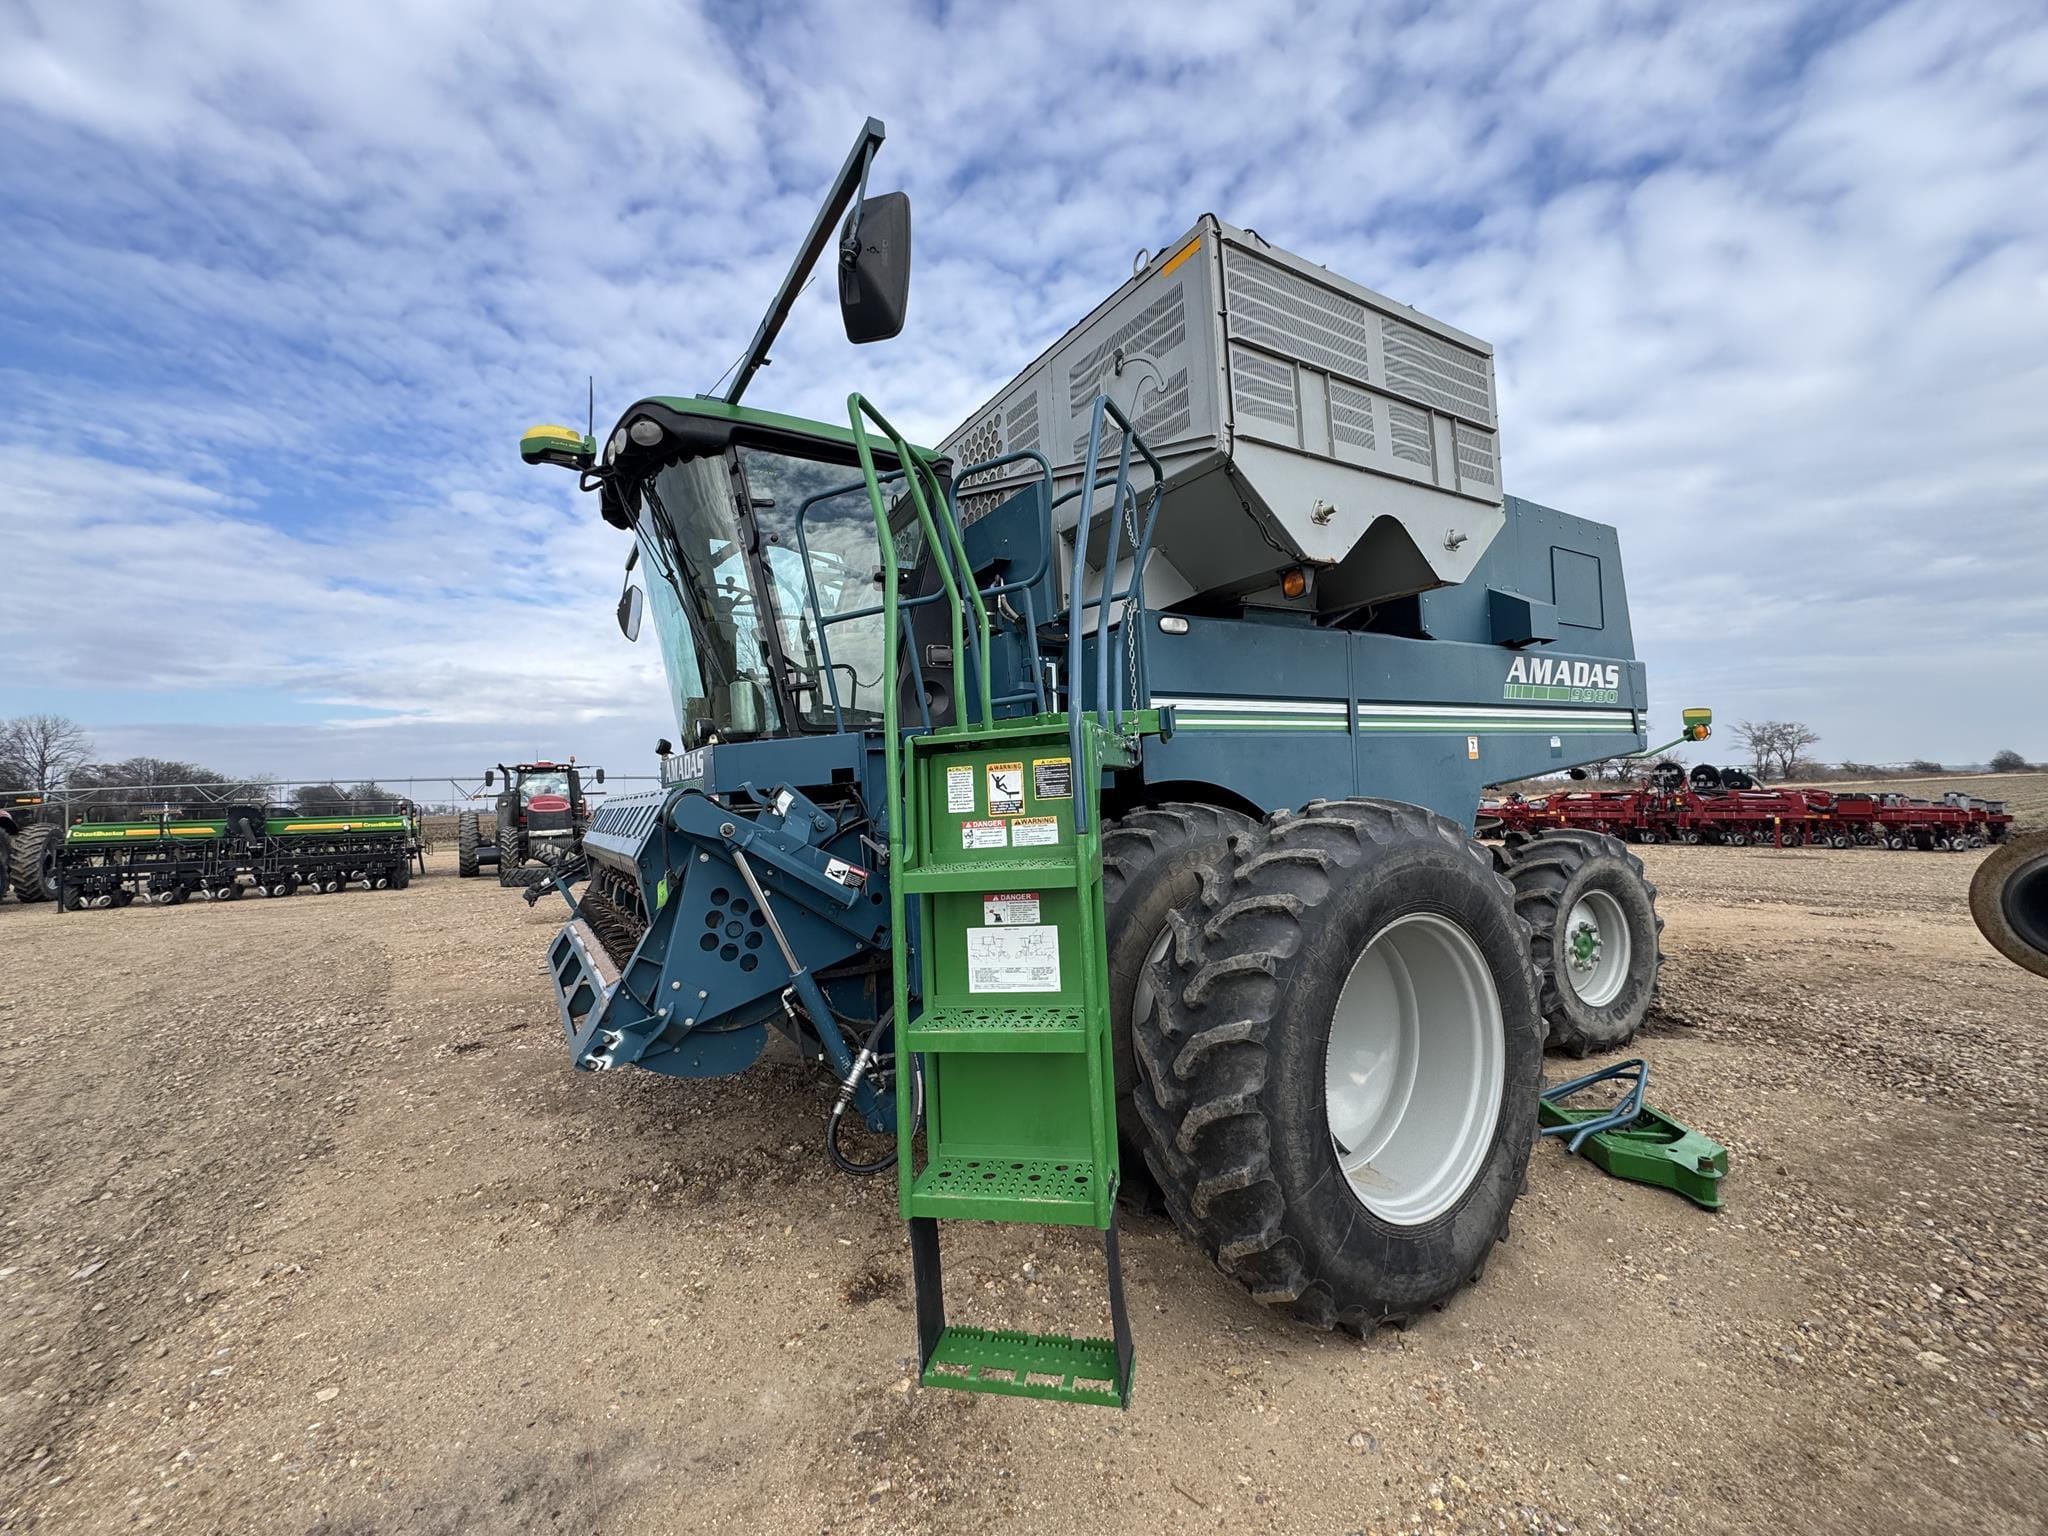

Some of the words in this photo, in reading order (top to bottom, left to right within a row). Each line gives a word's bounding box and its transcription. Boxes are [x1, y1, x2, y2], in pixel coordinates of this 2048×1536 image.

[1505, 656, 1619, 689] AMADAS
[1570, 687, 1618, 703] 9980
[665, 750, 704, 784] AMADAS
[1021, 817, 1055, 825] WARNING
